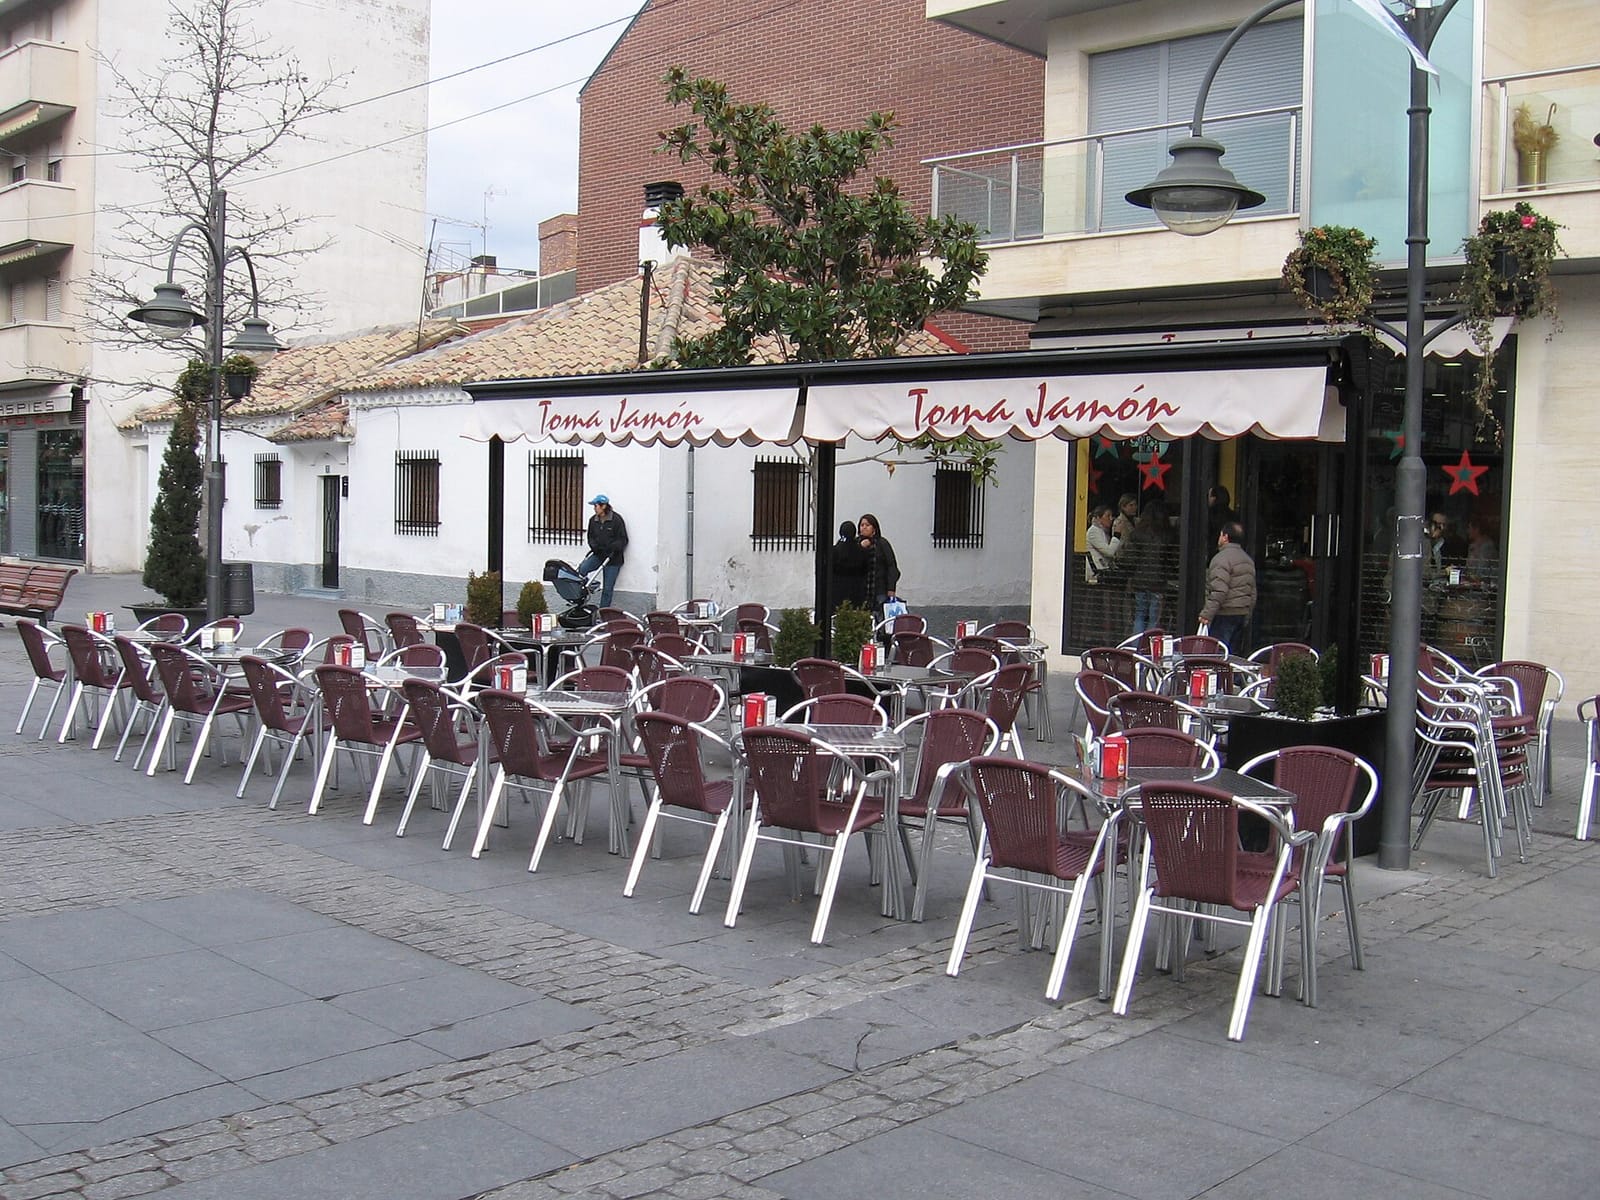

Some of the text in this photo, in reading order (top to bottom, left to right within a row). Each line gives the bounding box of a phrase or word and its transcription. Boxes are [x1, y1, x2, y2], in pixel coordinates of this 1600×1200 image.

[538, 398, 704, 434] Toma Jamón
[908, 377, 1180, 431] Toma Jamón
